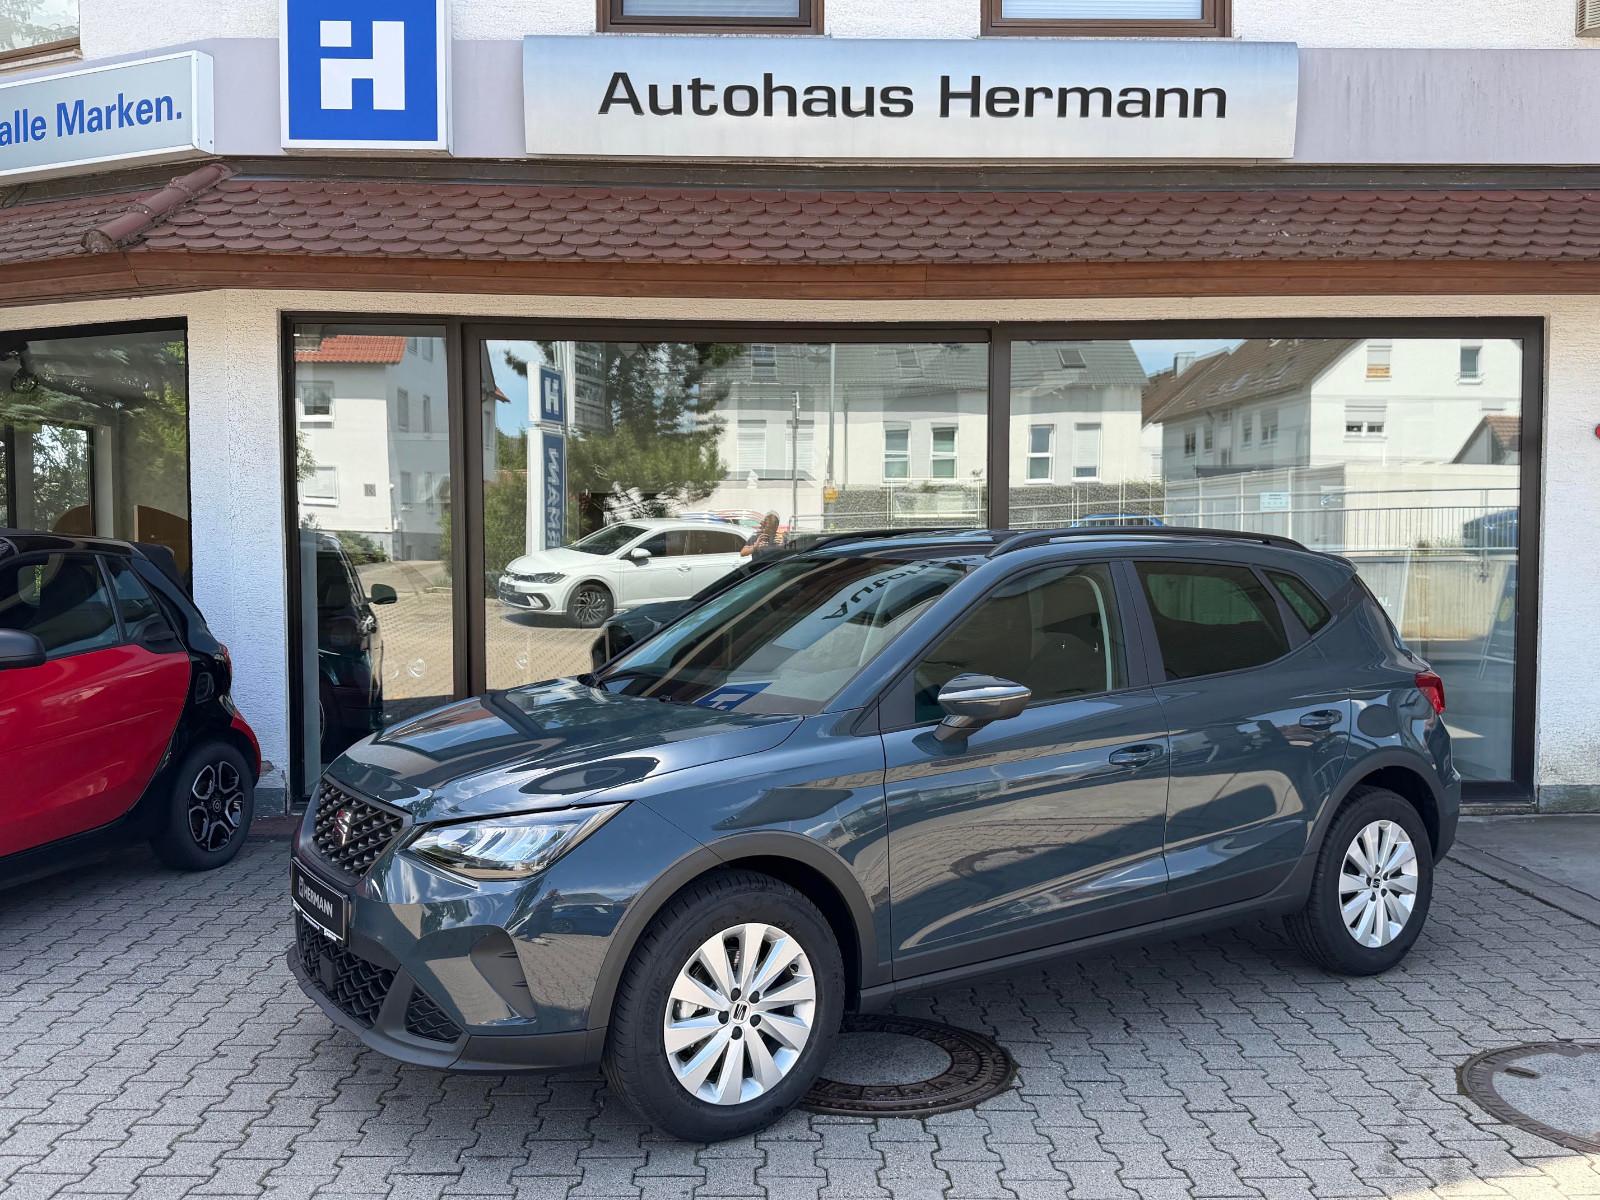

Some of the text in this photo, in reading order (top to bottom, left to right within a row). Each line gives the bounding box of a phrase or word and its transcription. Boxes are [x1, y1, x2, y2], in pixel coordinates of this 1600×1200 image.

[599, 73, 1226, 118] Autohaus Hermann
[0, 92, 182, 146] alle Marken.
[304, 883, 333, 918] HERMANN
